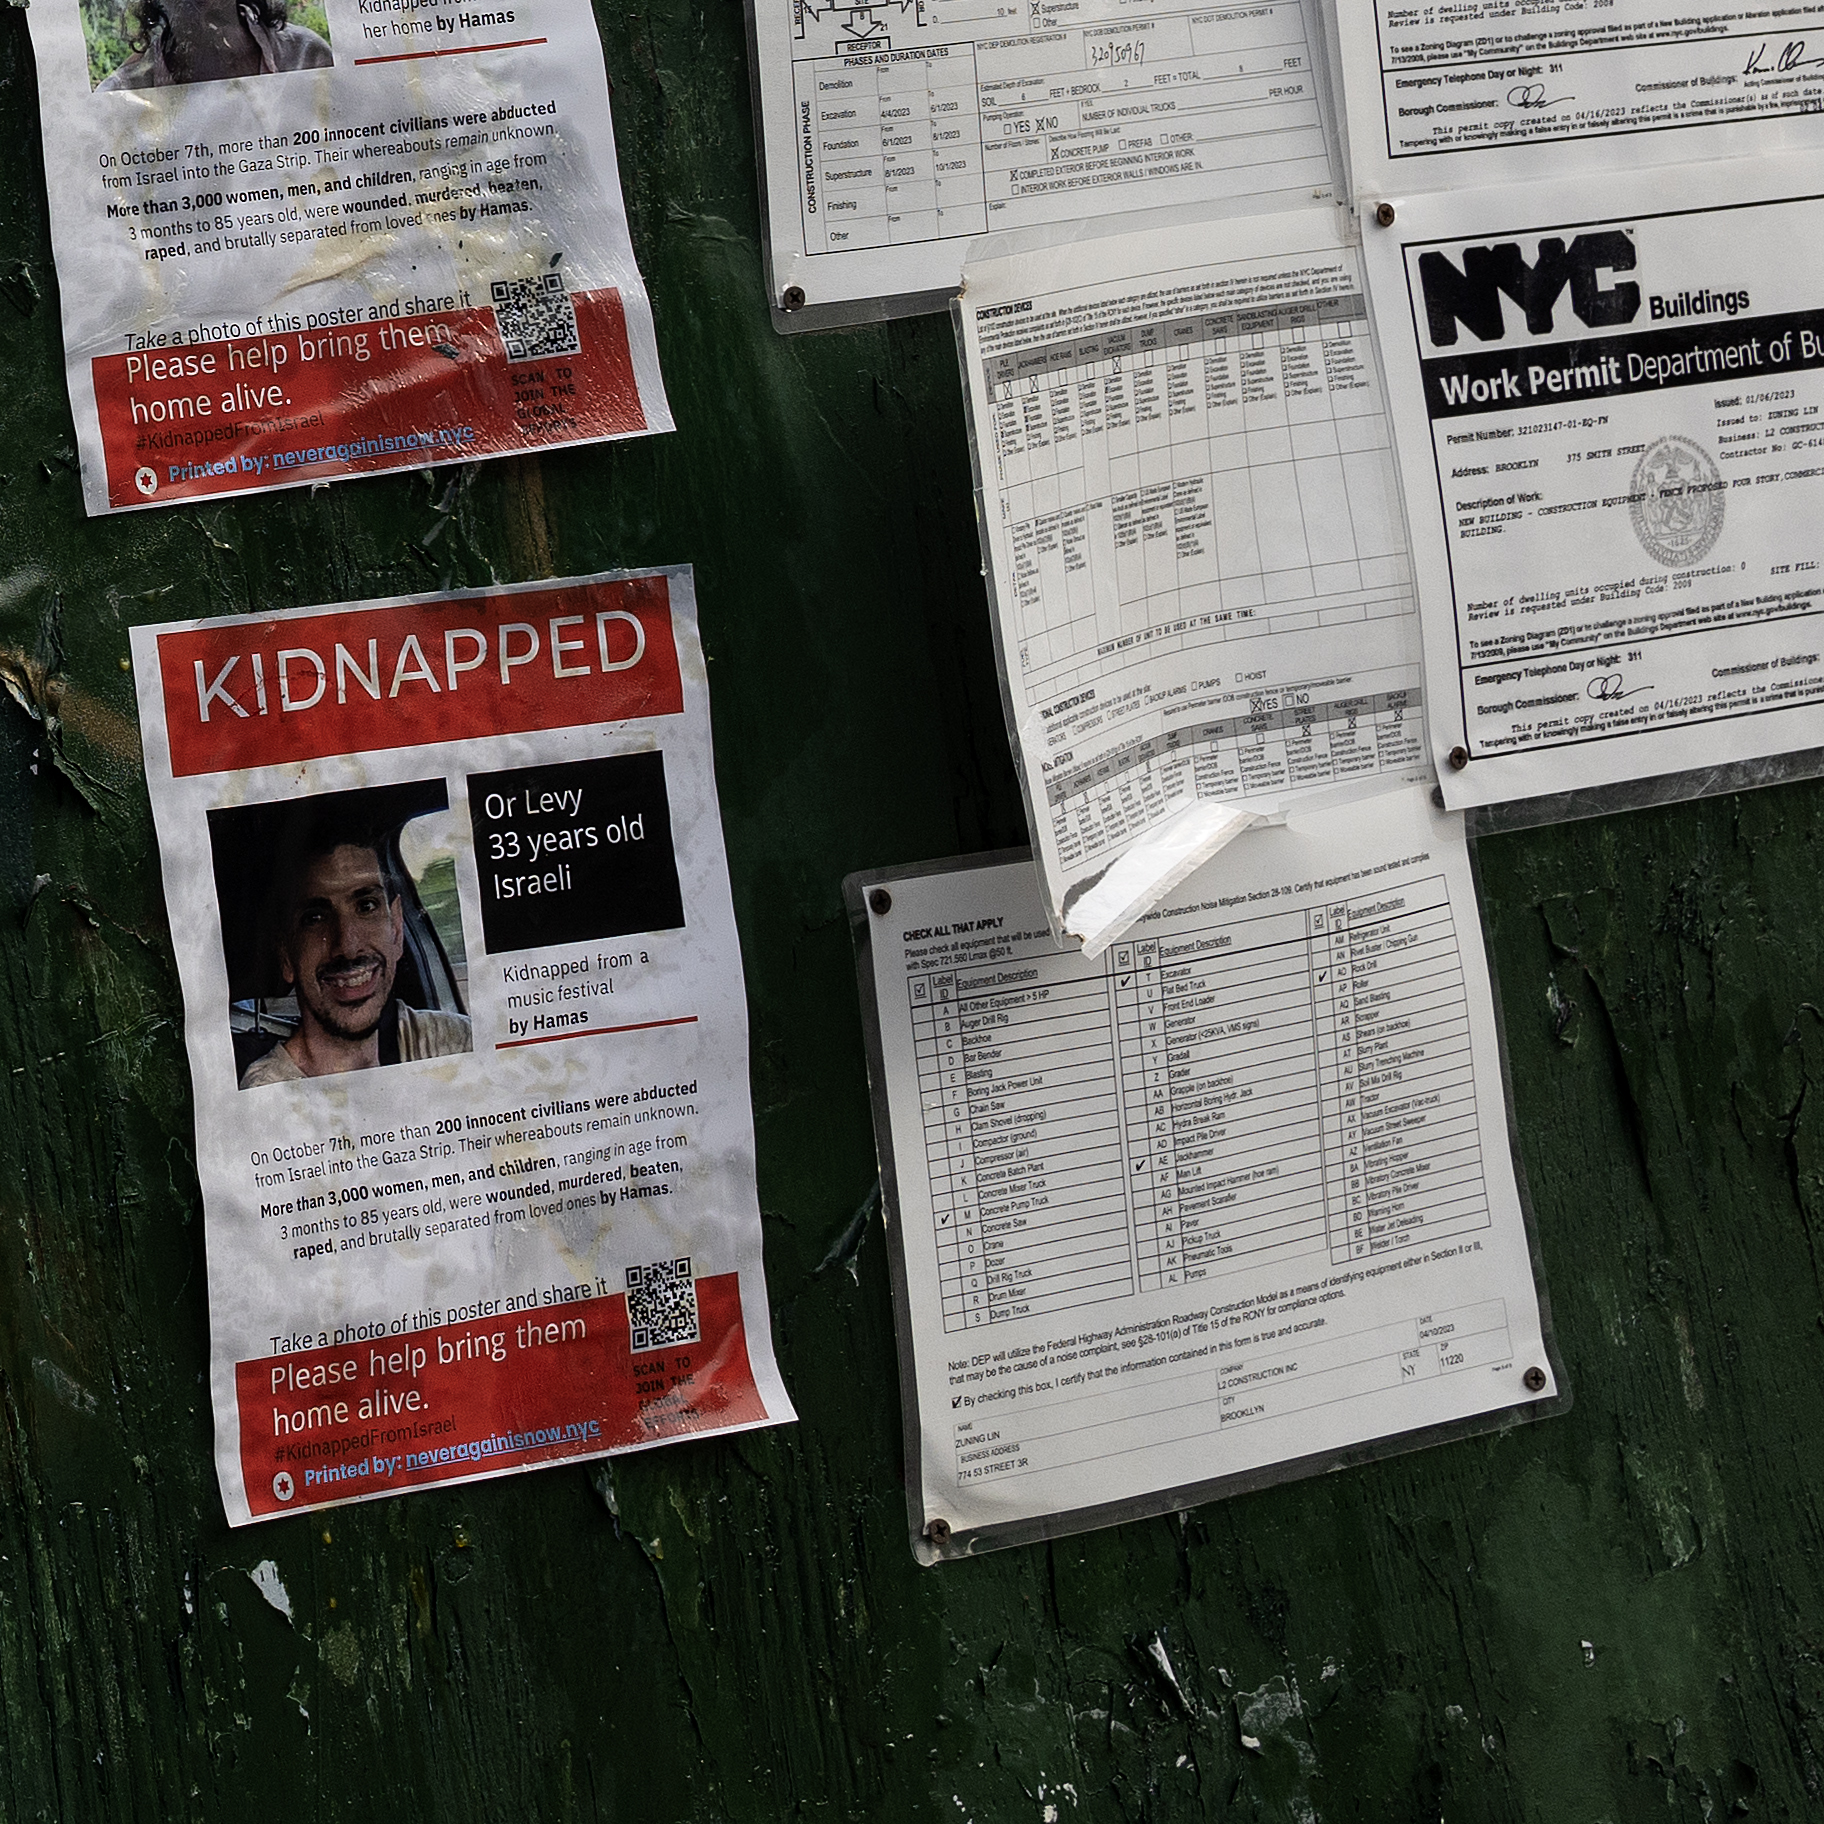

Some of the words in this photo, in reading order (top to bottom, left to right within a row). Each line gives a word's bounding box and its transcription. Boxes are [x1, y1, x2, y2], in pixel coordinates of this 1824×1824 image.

[1418, 229, 1640, 347] NYC
[1649, 289, 1750, 320] Buildings
[1440, 374, 1523, 405] Work
[1529, 358, 1622, 394] Permit
[1627, 346, 1762, 383] Department
[193, 610, 647, 722] KIDNAPPED
[484, 791, 516, 819] Or
[524, 786, 583, 819] Levy
[488, 832, 520, 859] 33
[526, 822, 598, 861] years
[607, 816, 644, 845] old
[492, 865, 572, 899] Israeli
